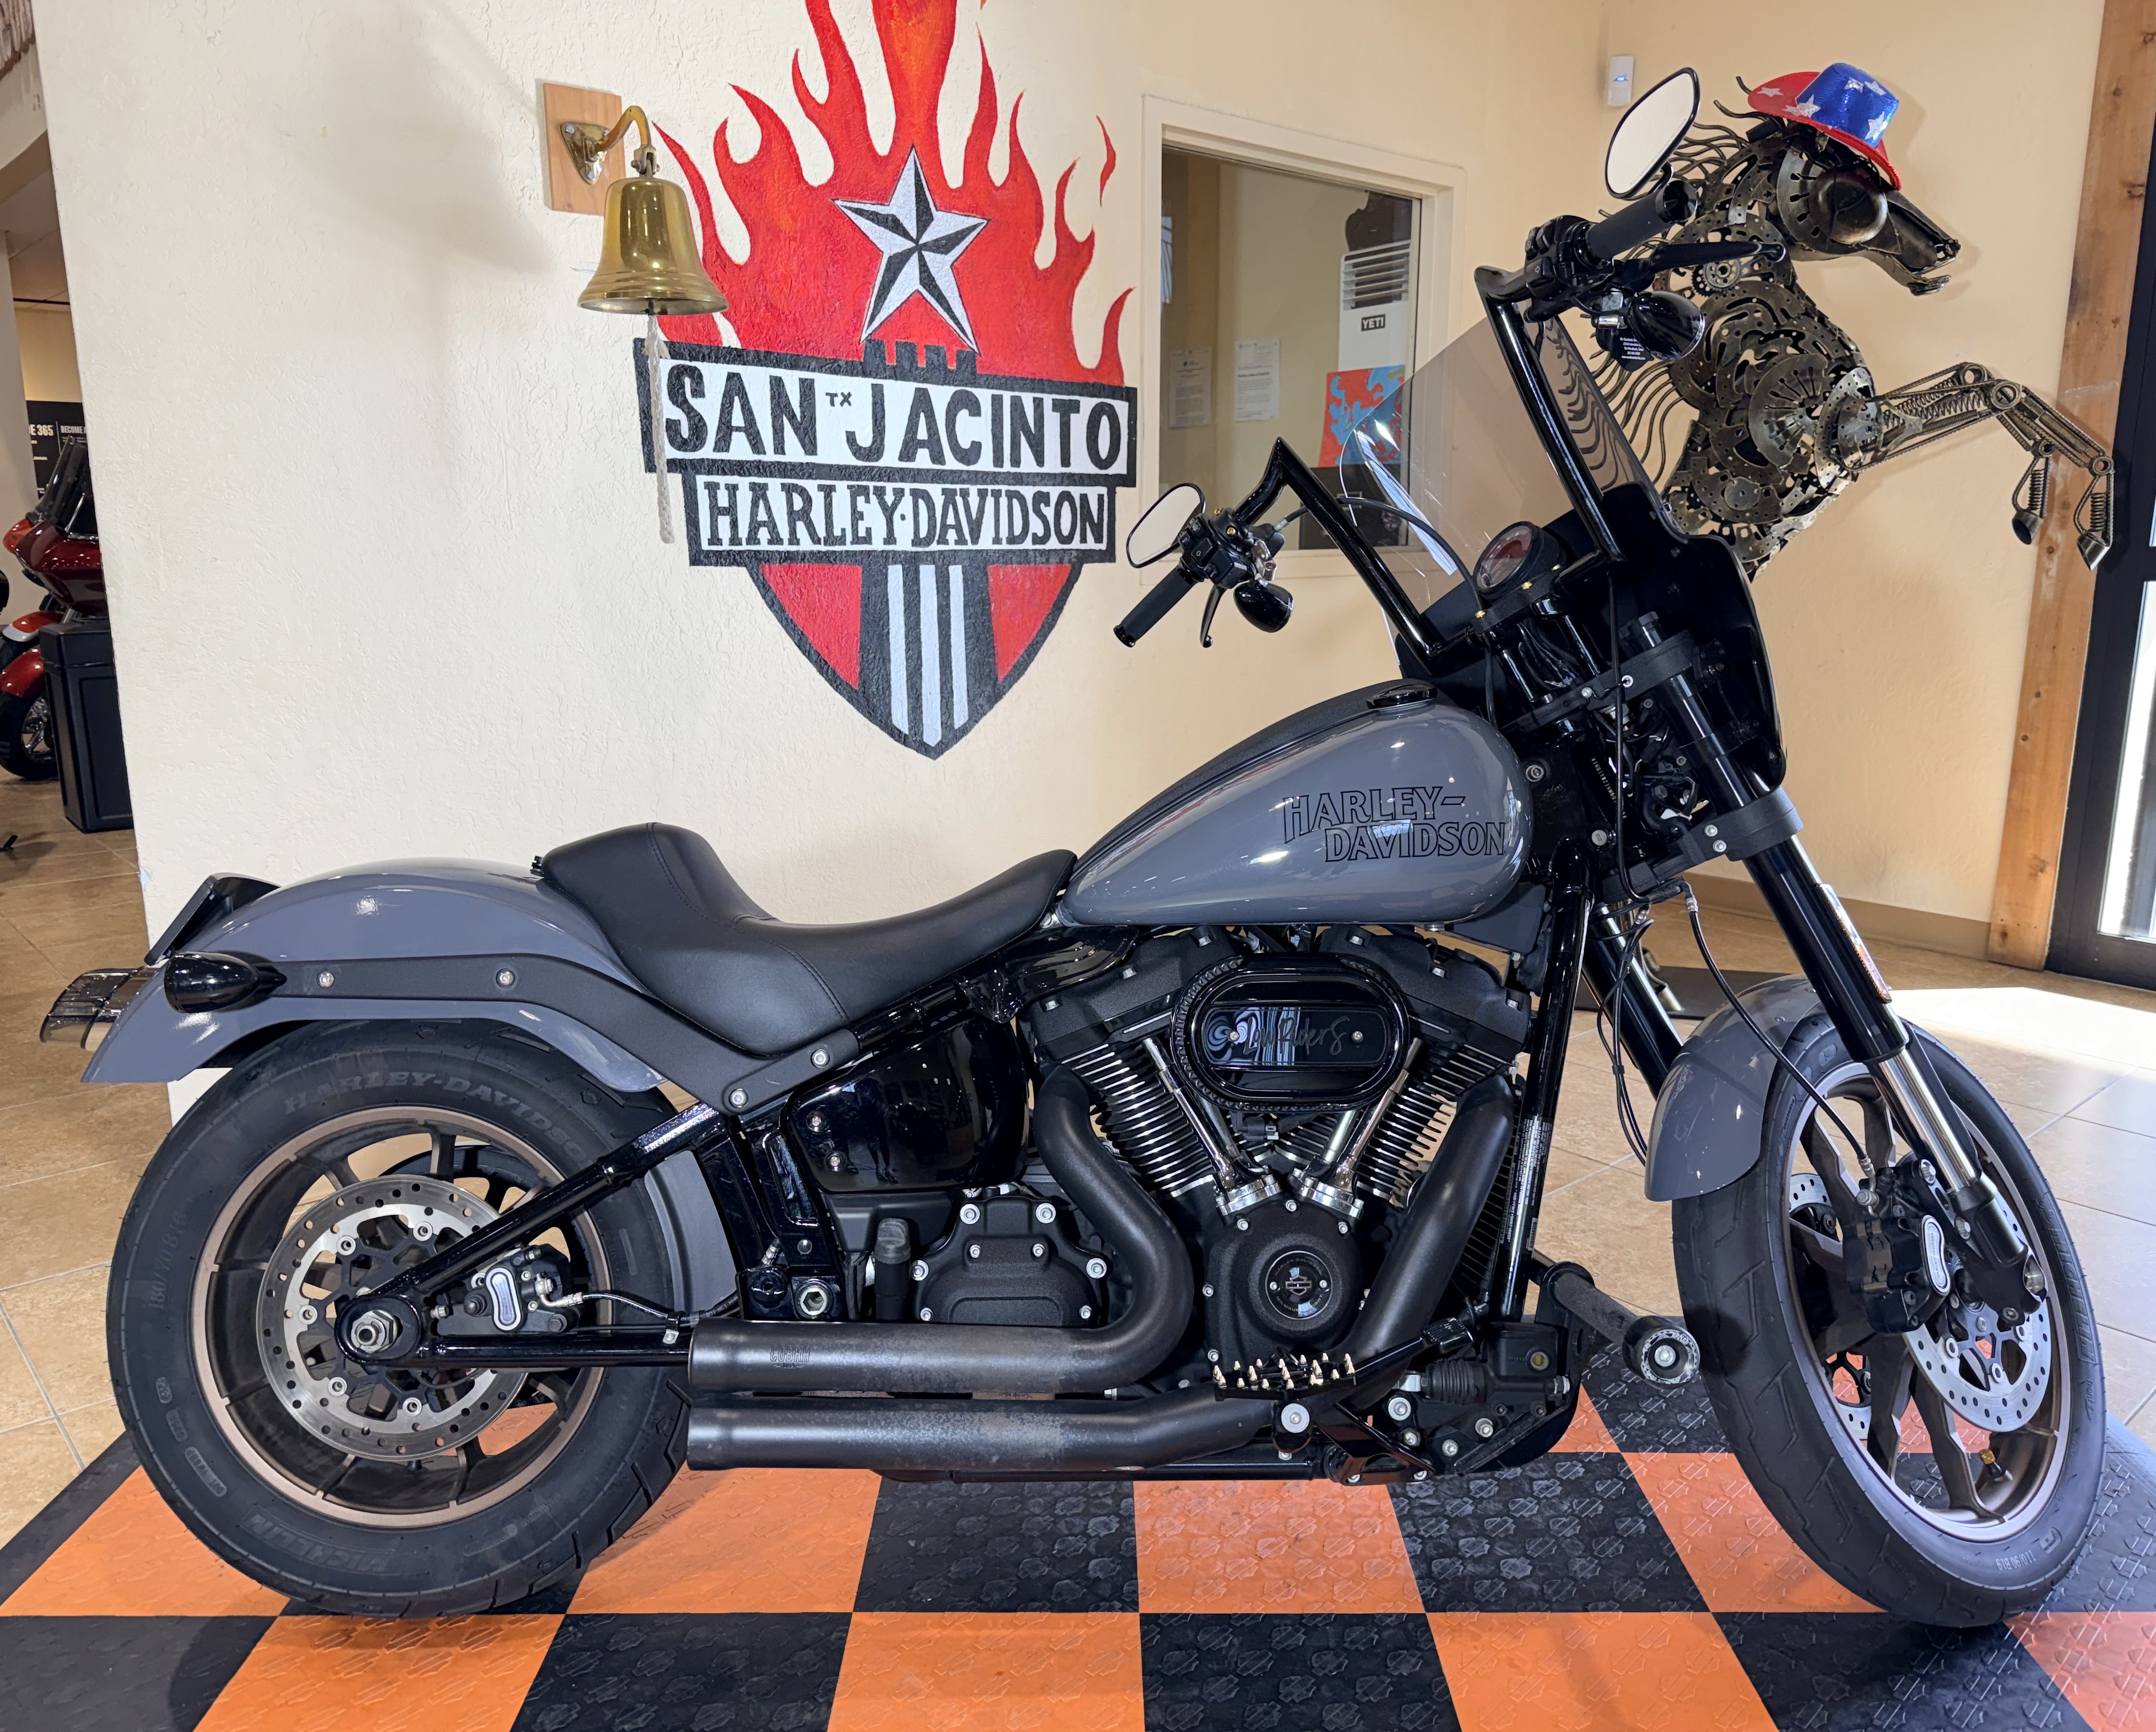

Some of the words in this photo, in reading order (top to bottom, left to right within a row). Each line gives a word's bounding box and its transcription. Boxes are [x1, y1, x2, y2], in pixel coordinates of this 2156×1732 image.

[1363, 317, 1384, 329] YETI
[665, 364, 818, 457] SAN
[825, 391, 852, 408] TX
[845, 382, 1123, 471] JACINTO
[37, 424, 53, 436] 365
[60, 426, 83, 434] BECOME
[1282, 786, 1466, 844] HARLEY-
[1324, 821, 1506, 863] DAVIDSON
[2048, 1229, 2095, 1361] MICHELIN
[770, 1345, 811, 1363] COBRA
[2009, 1549, 2036, 1568] 110/90
